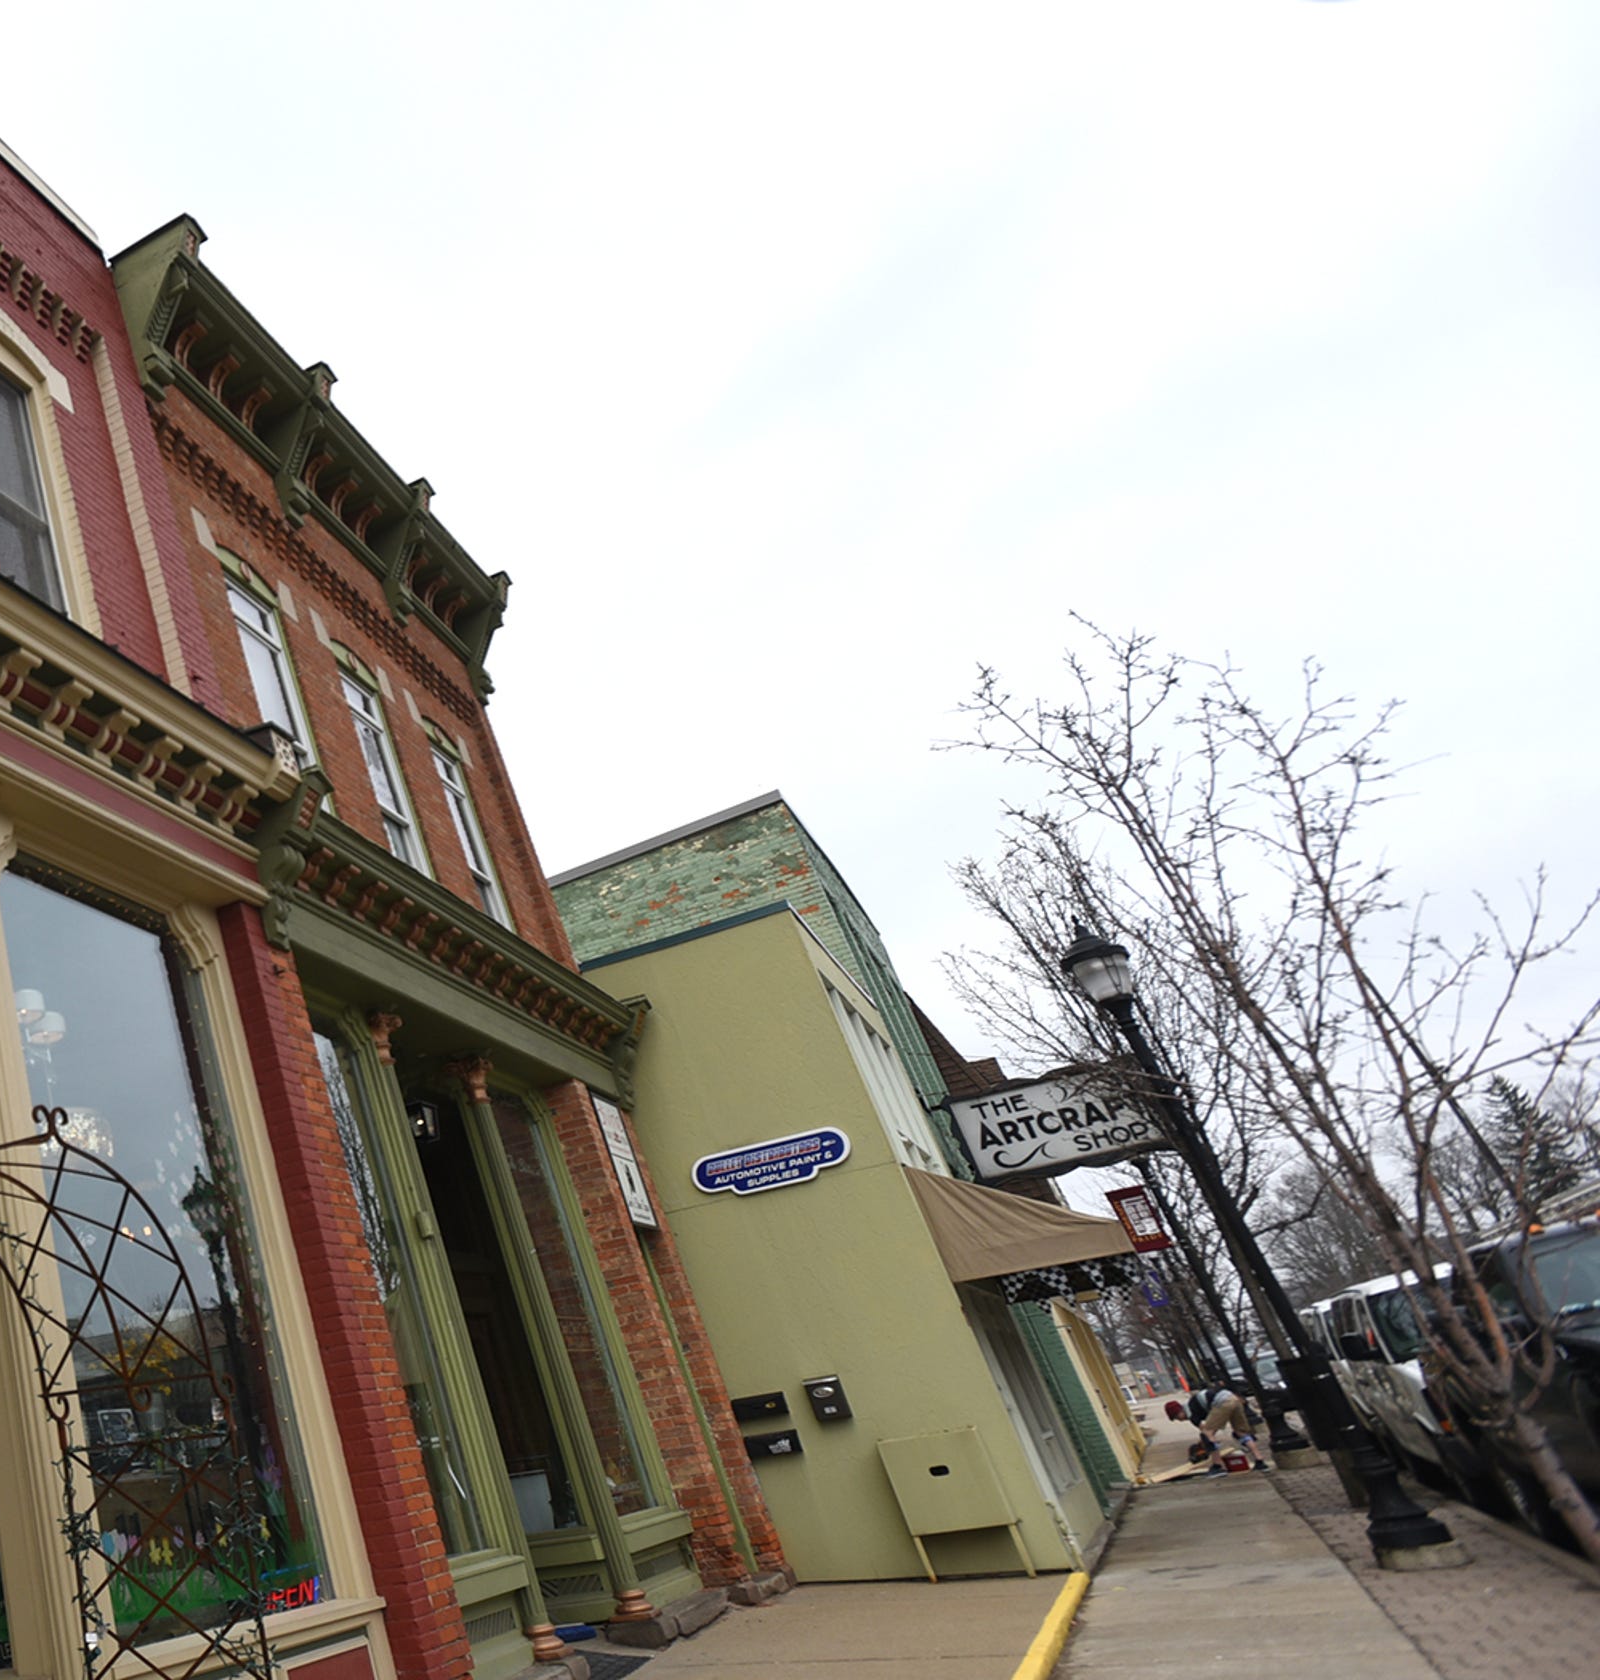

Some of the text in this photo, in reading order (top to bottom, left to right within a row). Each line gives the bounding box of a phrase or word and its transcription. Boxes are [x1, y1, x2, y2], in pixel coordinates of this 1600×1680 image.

[970, 1094, 1031, 1120] THE
[980, 1094, 1144, 1151] ARTCRAF
[1073, 1121, 1149, 1153] SHOP
[714, 1161, 786, 1185] AUTOMOTIVE
[789, 1152, 822, 1168] PAINT
[747, 1168, 800, 1188] SUPPLIES
[265, 1577, 314, 1611] PEN
